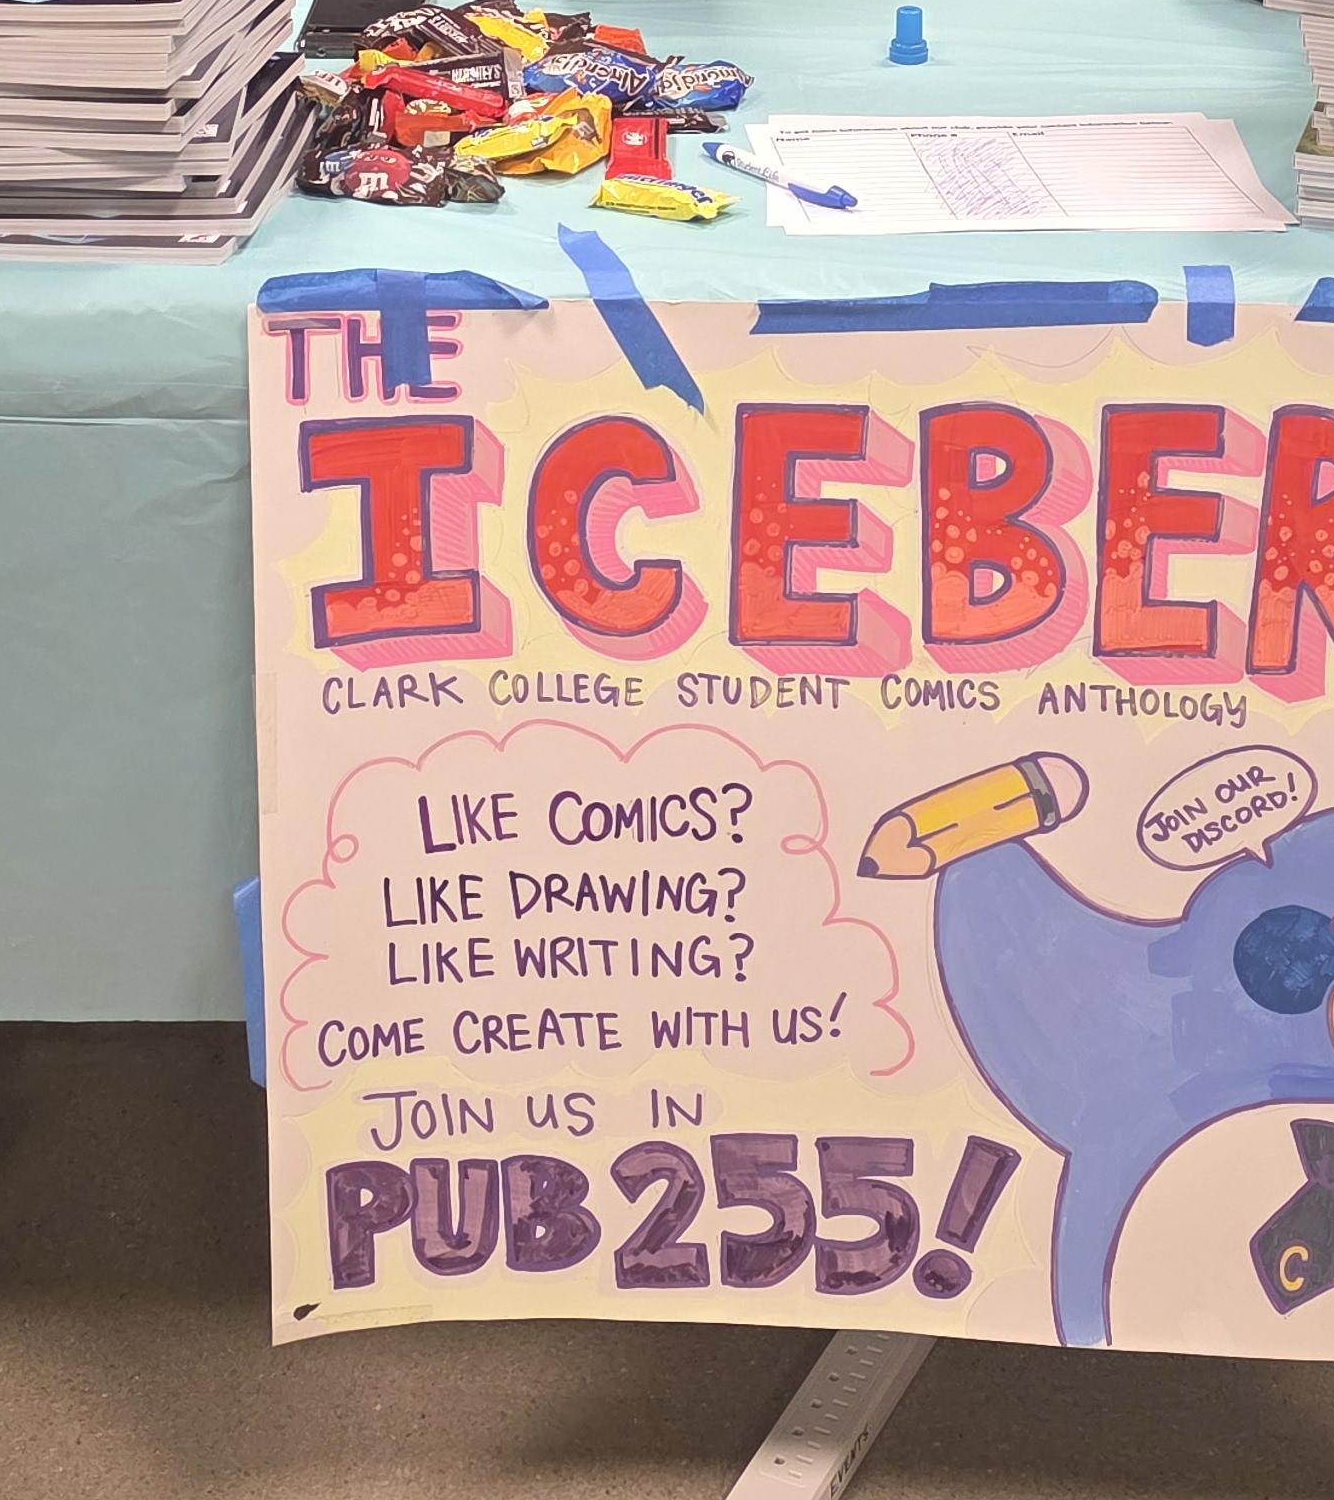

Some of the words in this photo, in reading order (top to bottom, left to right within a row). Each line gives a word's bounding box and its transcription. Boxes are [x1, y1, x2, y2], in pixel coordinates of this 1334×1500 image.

[264, 312, 463, 404] THE
[322, 671, 465, 715] CLARK
[488, 670, 645, 707] COLLEGE
[676, 674, 851, 710] STUDENT
[879, 674, 1002, 713] COMICS
[1037, 682, 1249, 729] ANTHOLOGY
[417, 792, 518, 854] LIKE
[548, 783, 753, 845] COMICS?
[1145, 796, 1208, 843] JOIN
[1214, 765, 1276, 802] OUR
[1180, 771, 1297, 853] DISCORD!
[382, 874, 484, 928] LIKE
[509, 867, 747, 922] DRAWING?
[387, 937, 495, 985] LIKE
[513, 932, 755, 982] WRITING?
[317, 1017, 426, 1067] COME
[453, 1008, 622, 1054] CREATE
[650, 1006, 750, 1050] WITH
[771, 991, 848, 1045] US!
[363, 1090, 495, 1150] JOIN
[526, 1092, 596, 1136] US
[650, 1088, 704, 1128] IN
[324, 1153, 602, 1291] PUB
[610, 1133, 1023, 1299] 255!
[1277, 1244, 1310, 1292] C
